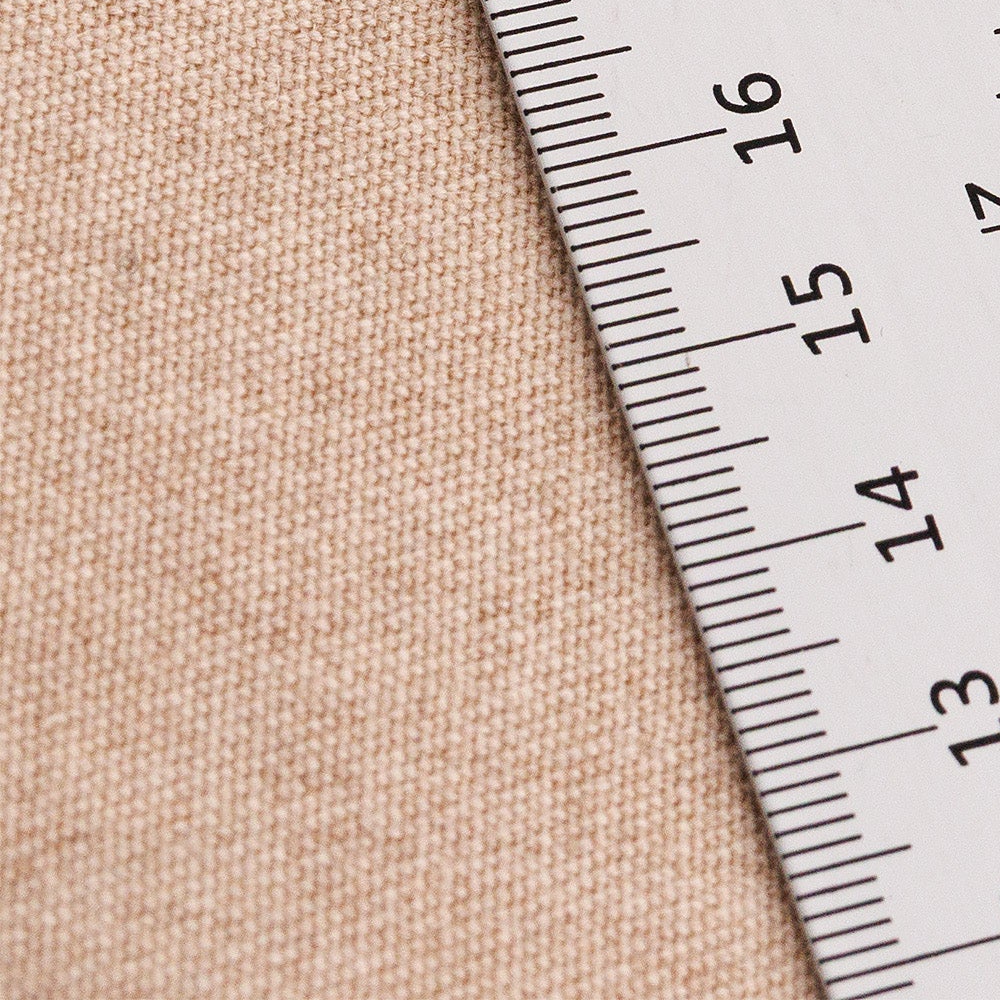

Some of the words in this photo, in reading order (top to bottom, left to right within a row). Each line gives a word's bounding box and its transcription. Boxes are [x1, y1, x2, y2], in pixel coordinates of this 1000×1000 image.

[713, 73, 801, 164] 16
[781, 264, 870, 355] 15
[855, 466, 943, 562] 14
